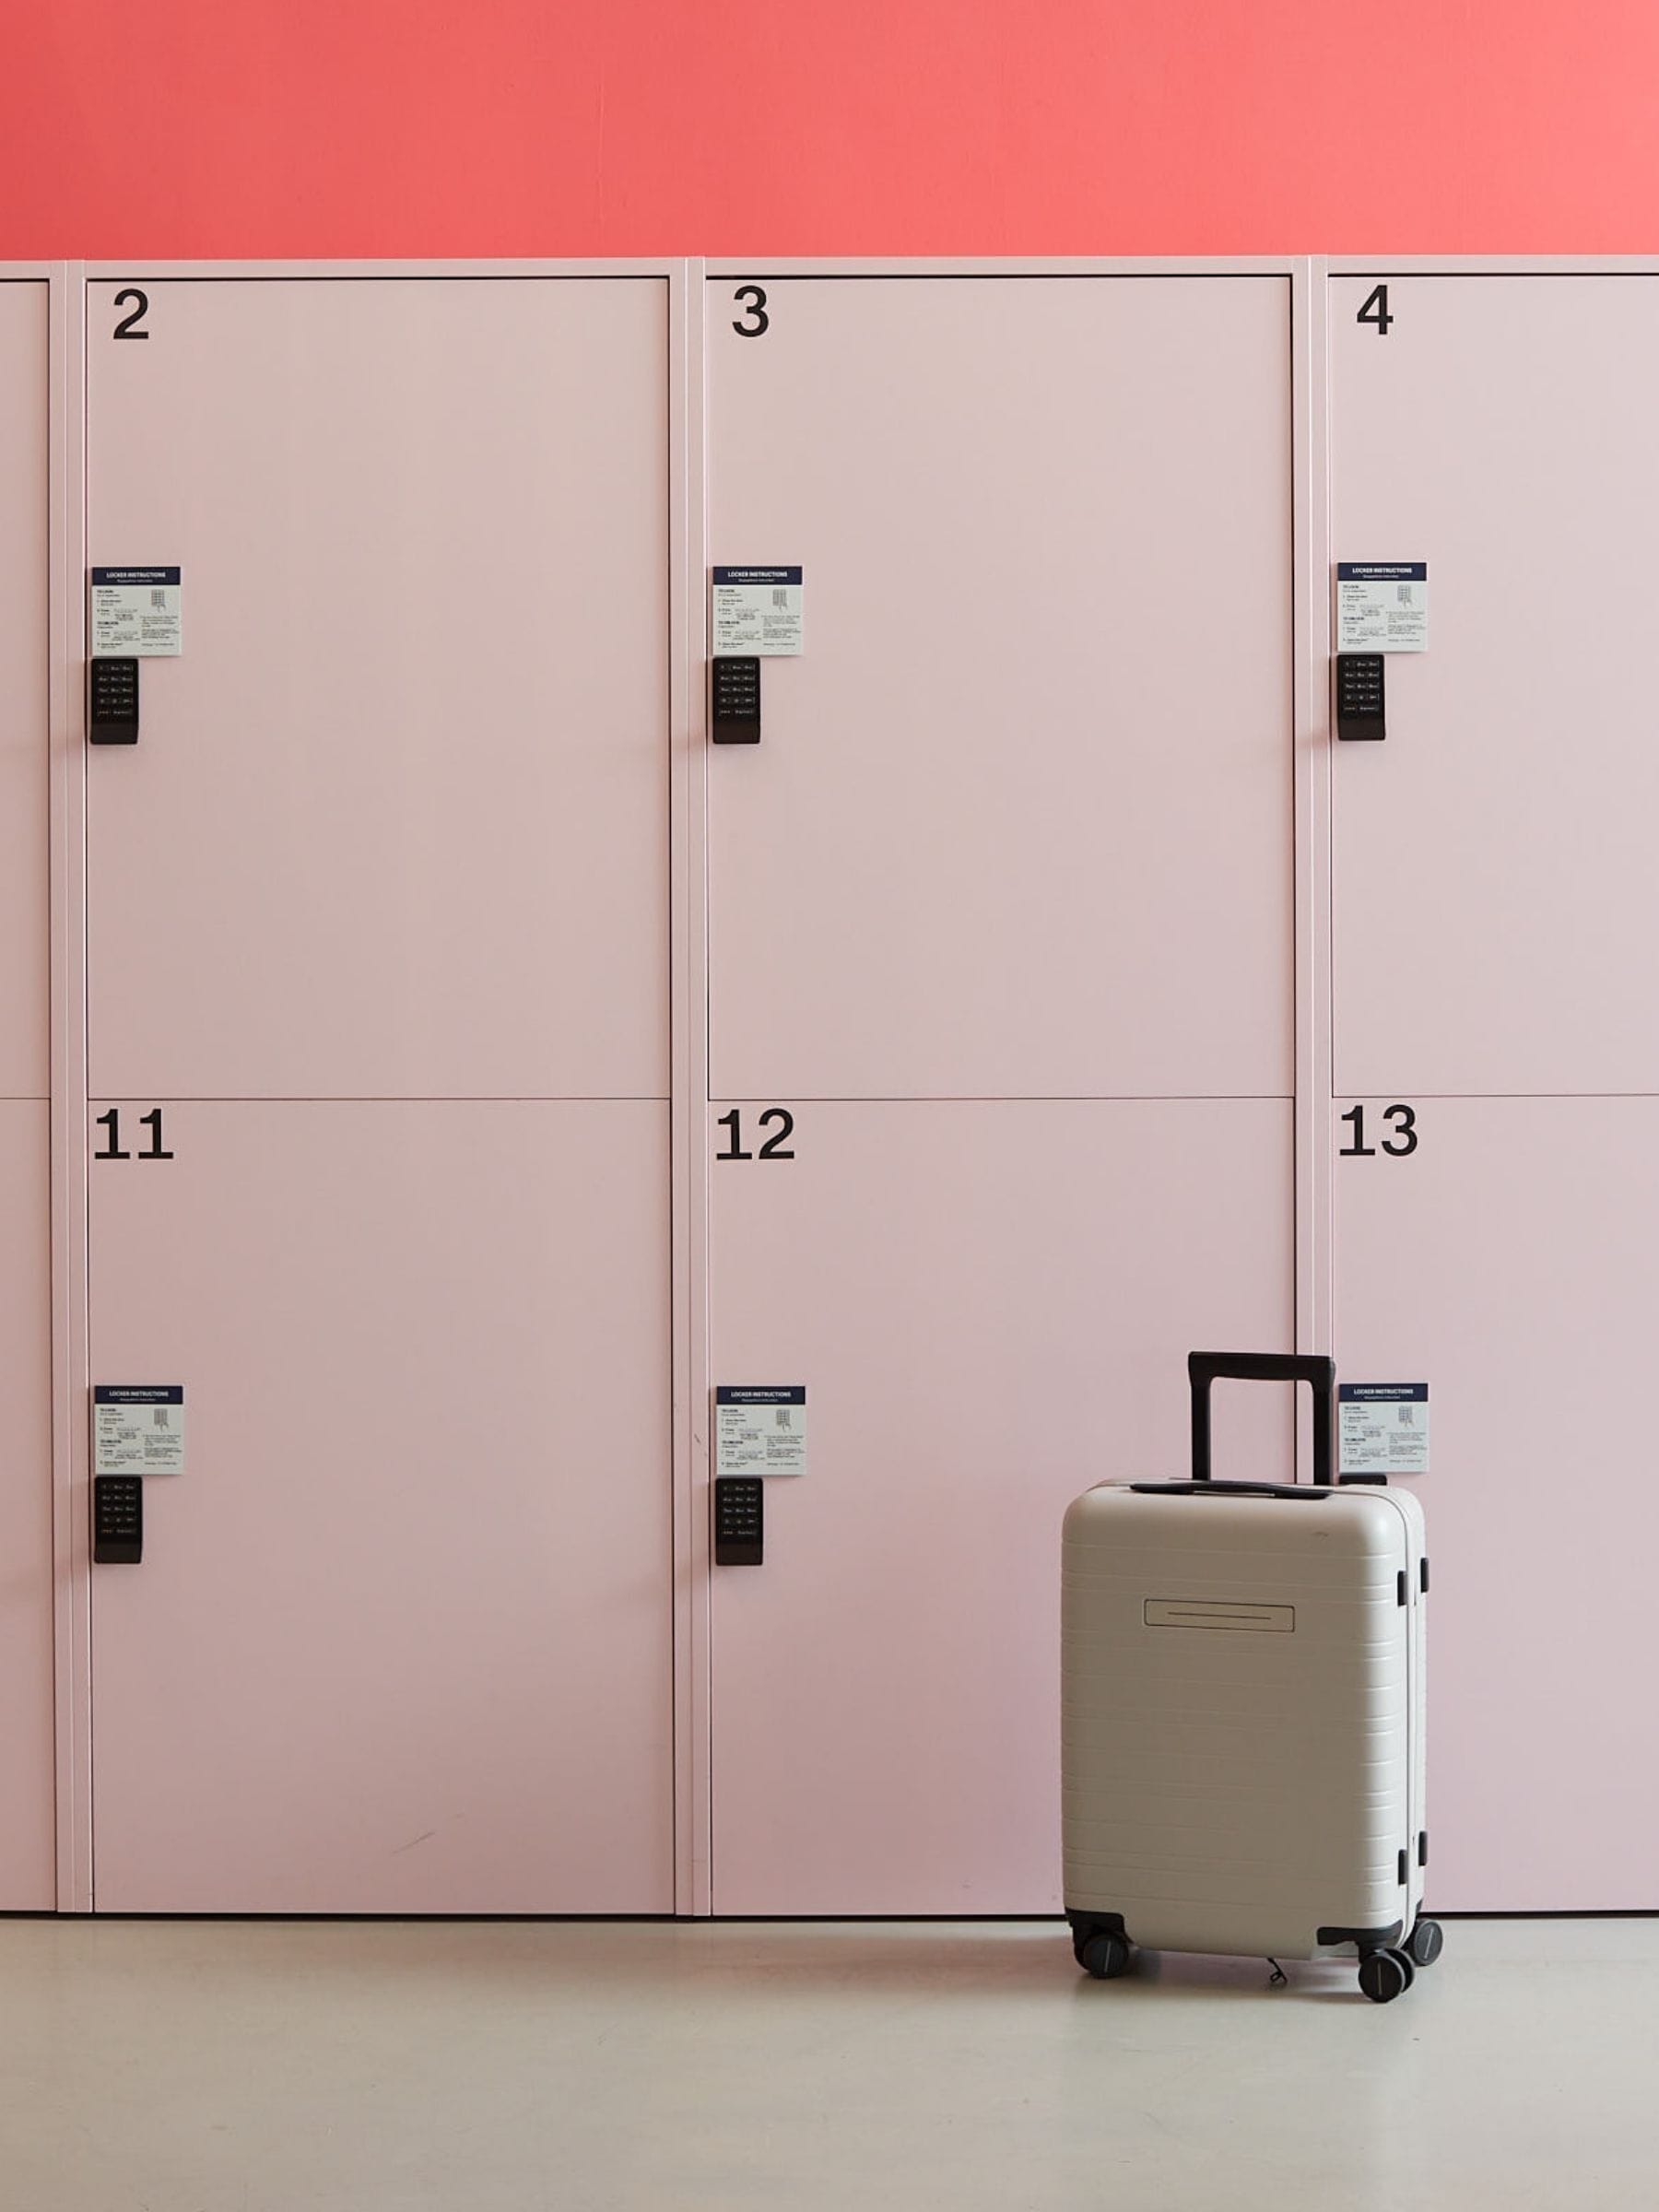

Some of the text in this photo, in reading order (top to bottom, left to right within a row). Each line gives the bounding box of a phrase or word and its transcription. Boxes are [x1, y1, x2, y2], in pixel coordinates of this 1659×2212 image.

[113, 288, 148, 339] 2
[733, 286, 769, 337] 3
[1358, 285, 1393, 335] 4
[95, 1109, 173, 1159] 11
[717, 1109, 794, 1159] 12
[1340, 1105, 1417, 1156] 13
